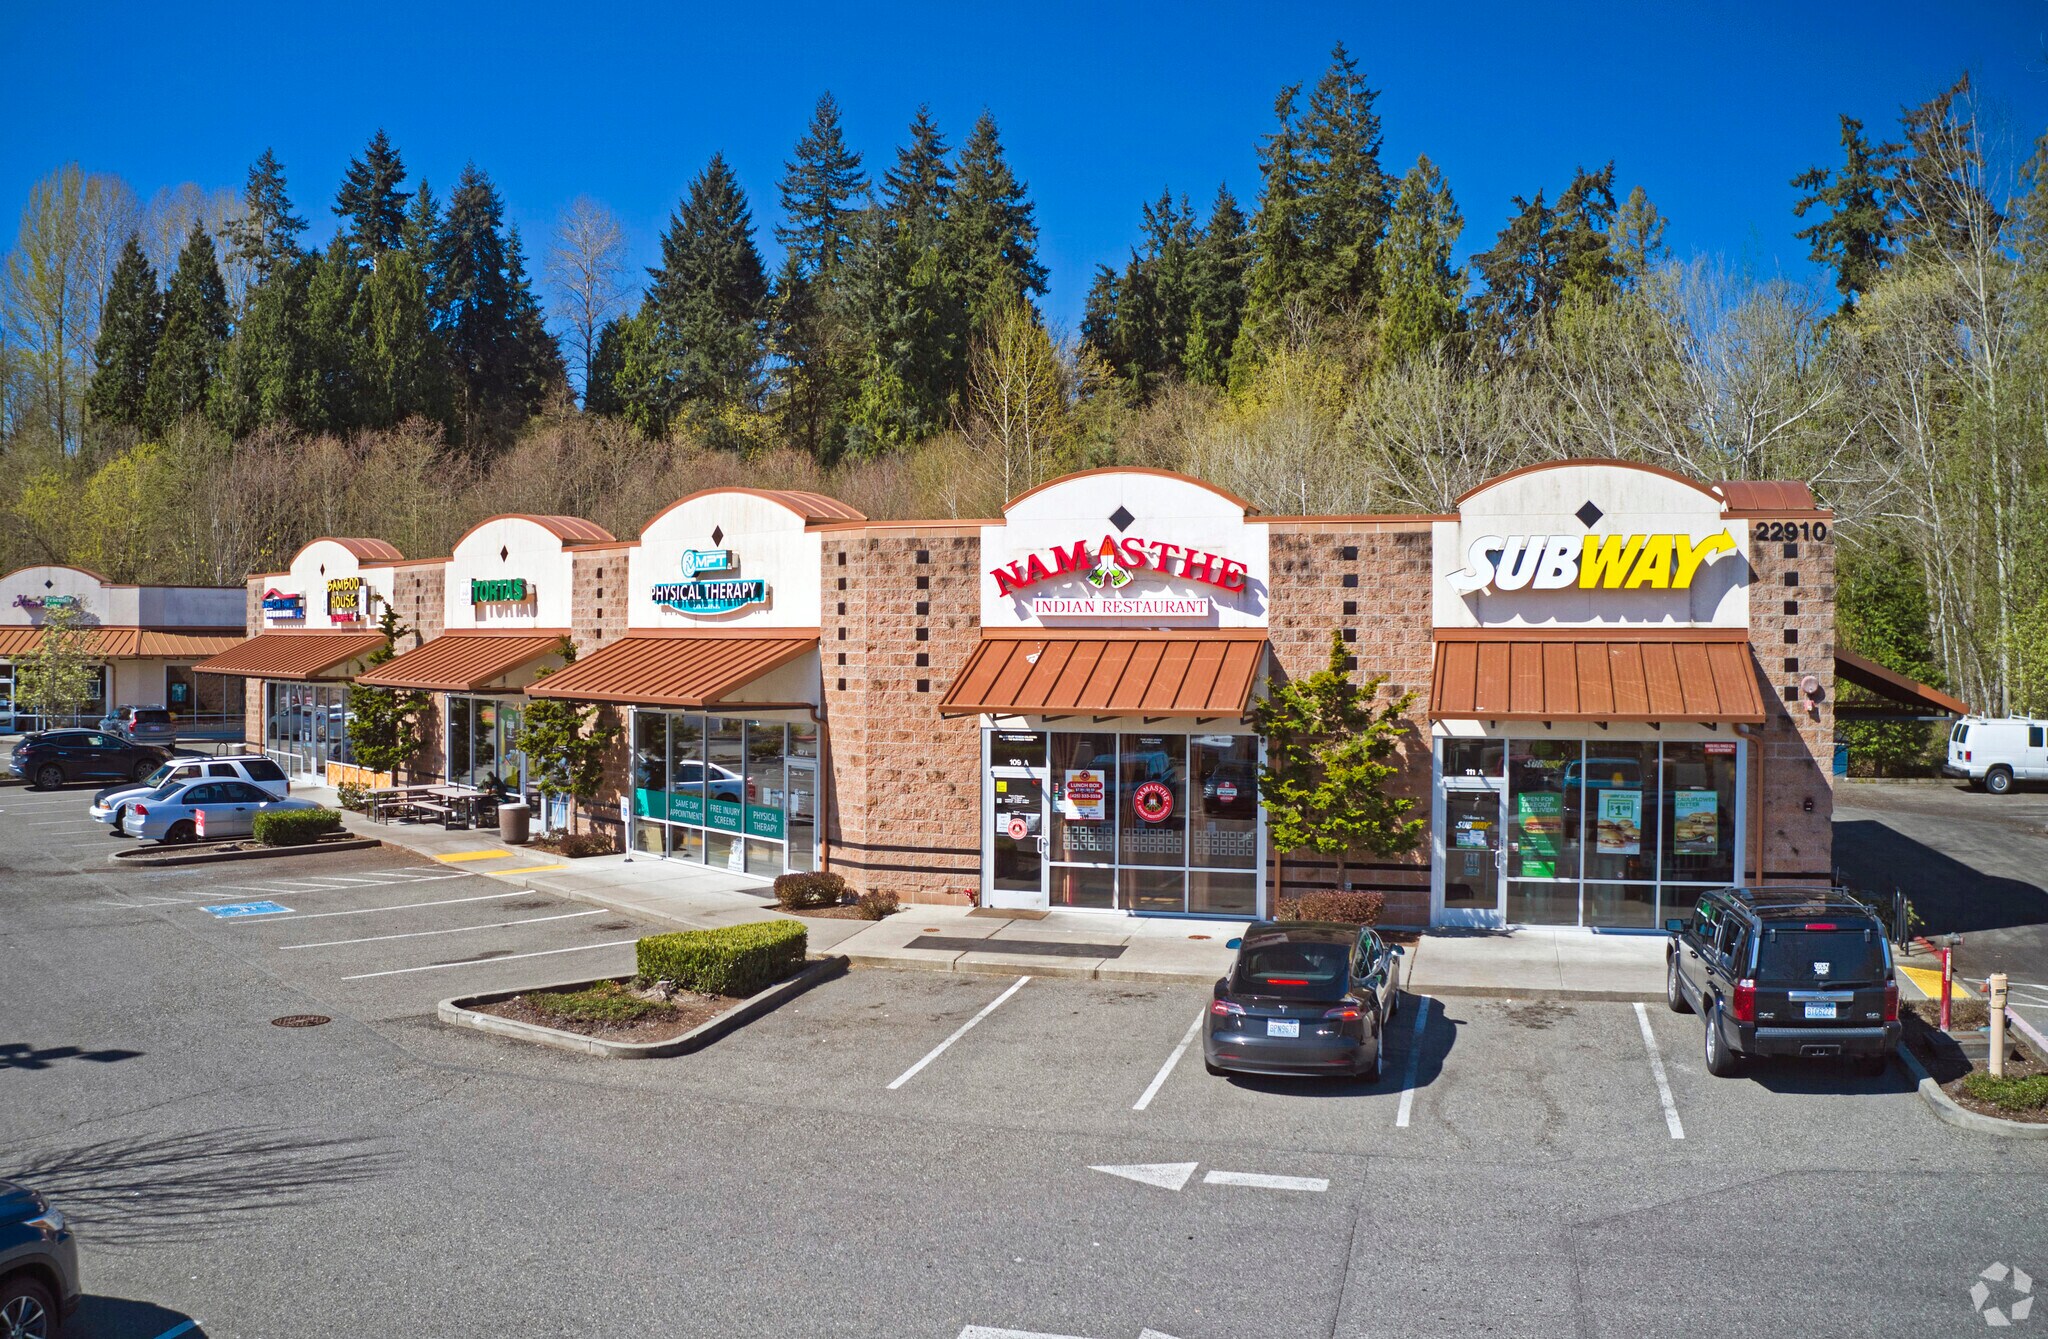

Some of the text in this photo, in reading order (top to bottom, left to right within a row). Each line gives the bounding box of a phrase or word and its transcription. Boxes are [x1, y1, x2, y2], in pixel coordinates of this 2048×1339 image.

[1755, 522, 1827, 542] 22910
[696, 554, 726, 568] MPT
[1446, 528, 1737, 592] SUBWAY
[327, 577, 359, 592] BAMBOO
[472, 578, 523, 602] TORTAS
[651, 582, 756, 601] PHYSICAL THERAPY
[331, 594, 356, 608] HOUSE
[1035, 600, 1206, 613] INDIAN RESTAURANT
[1524, 757, 1565, 768] SUBWAY
[1477, 768, 1484, 776] A
[1137, 785, 1170, 801] NAMASTHE
[675, 799, 699, 810] SAME DAY
[710, 804, 740, 817] FREE INJURY
[714, 815, 736, 826] SCREENS
[753, 810, 778, 823] PHYSICAL
[753, 821, 778, 833] THERAPY
[1455, 821, 1492, 829] SUBWAY
